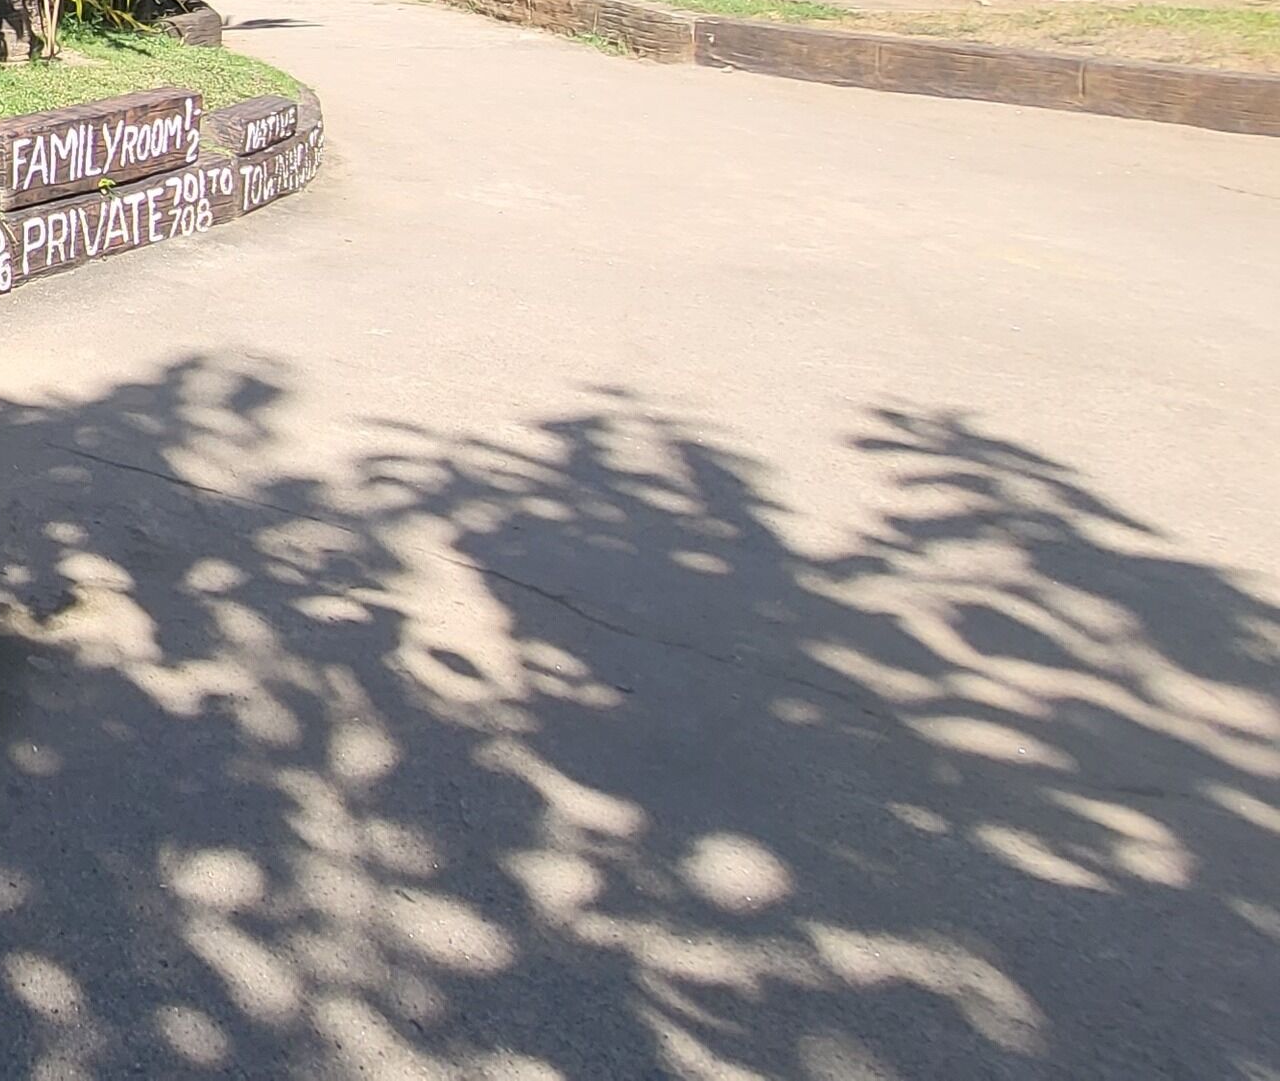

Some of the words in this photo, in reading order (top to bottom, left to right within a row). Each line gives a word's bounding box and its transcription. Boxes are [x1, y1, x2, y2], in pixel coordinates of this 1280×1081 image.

[244, 106, 297, 153] NATIVE
[22, 186, 164, 272] PRIVATE
[167, 199, 214, 239] 708
